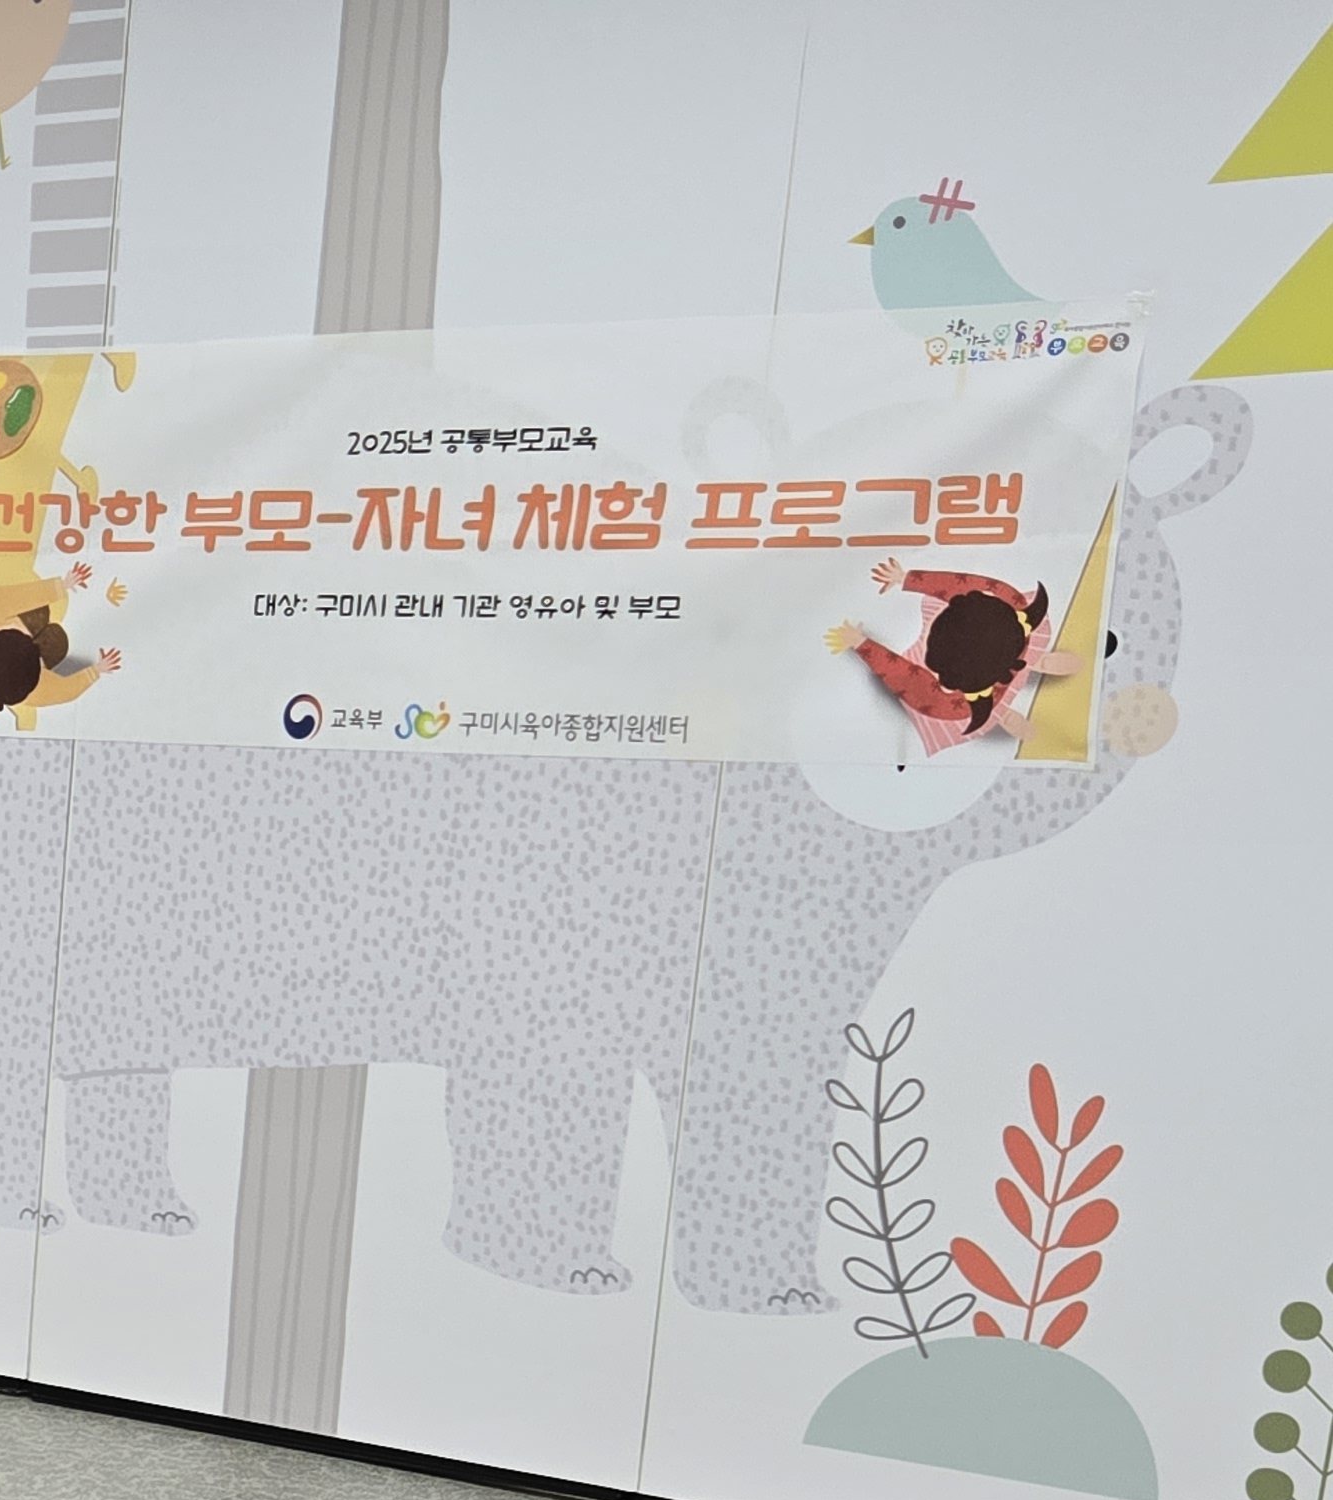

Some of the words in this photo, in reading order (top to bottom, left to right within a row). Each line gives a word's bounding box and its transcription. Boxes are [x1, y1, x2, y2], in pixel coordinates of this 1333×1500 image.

[346, 427, 432, 455] 2025년
[440, 426, 598, 453] 공통부모교육
[180, 486, 495, 550] 부모-자녀
[515, 482, 665, 549] 체험
[686, 473, 1022, 548] 프로그램
[254, 593, 308, 618] 대상:
[315, 594, 387, 618] 구미시
[395, 594, 444, 618] 관내
[453, 594, 502, 619] 기관
[509, 595, 586, 620] 영유아
[595, 594, 620, 619] 및
[628, 596, 681, 619] 부모
[331, 710, 382, 730] 교육부
[459, 712, 689, 743] 구미시육아종합지원센터
